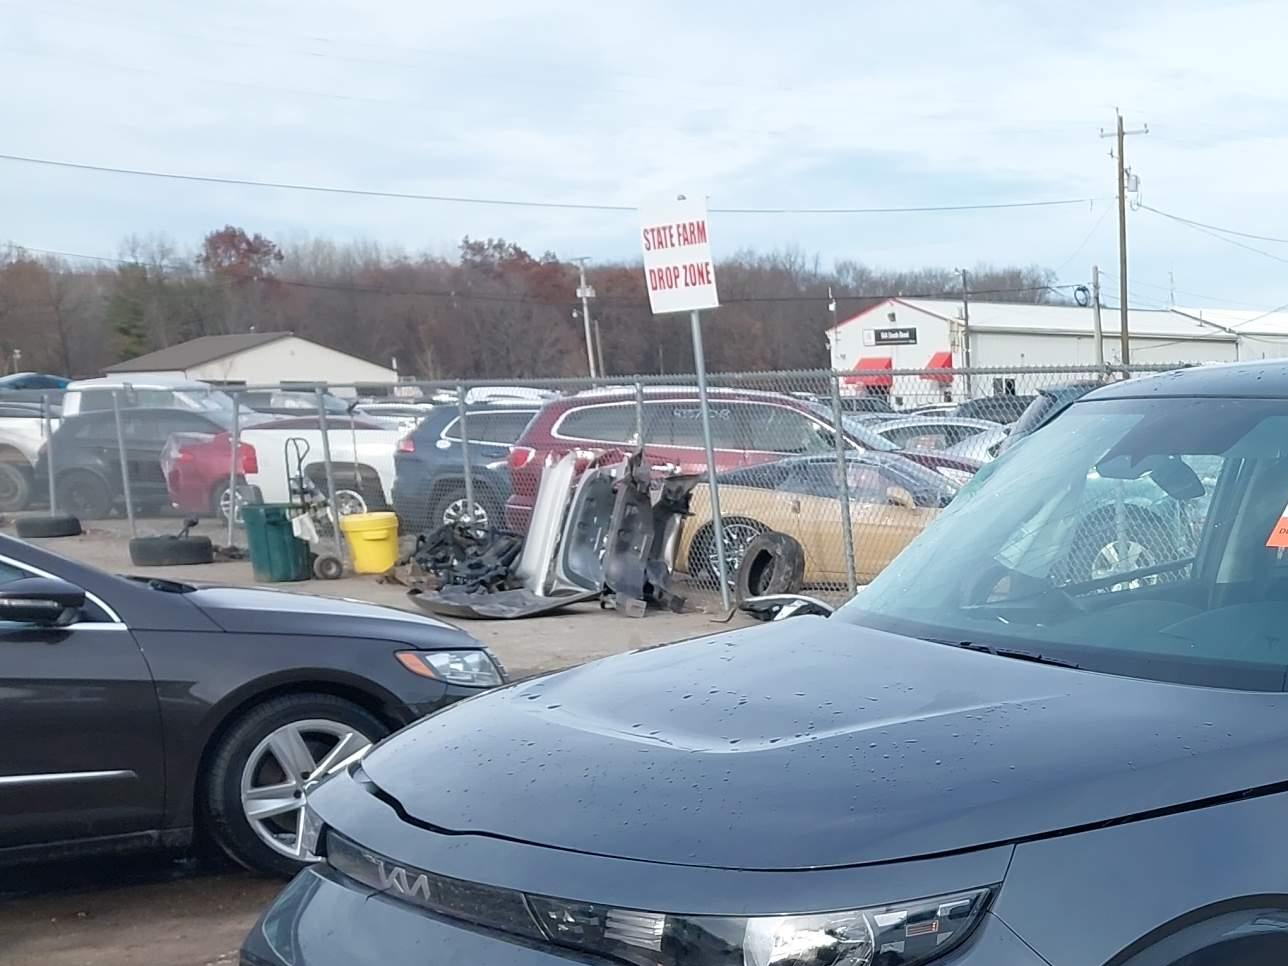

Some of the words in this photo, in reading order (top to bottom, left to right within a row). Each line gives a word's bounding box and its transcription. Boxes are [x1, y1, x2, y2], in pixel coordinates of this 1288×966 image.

[643, 225, 675, 251] STATE
[677, 220, 707, 247] FARM
[649, 266, 680, 291] DROP
[683, 262, 712, 287] ZONE
